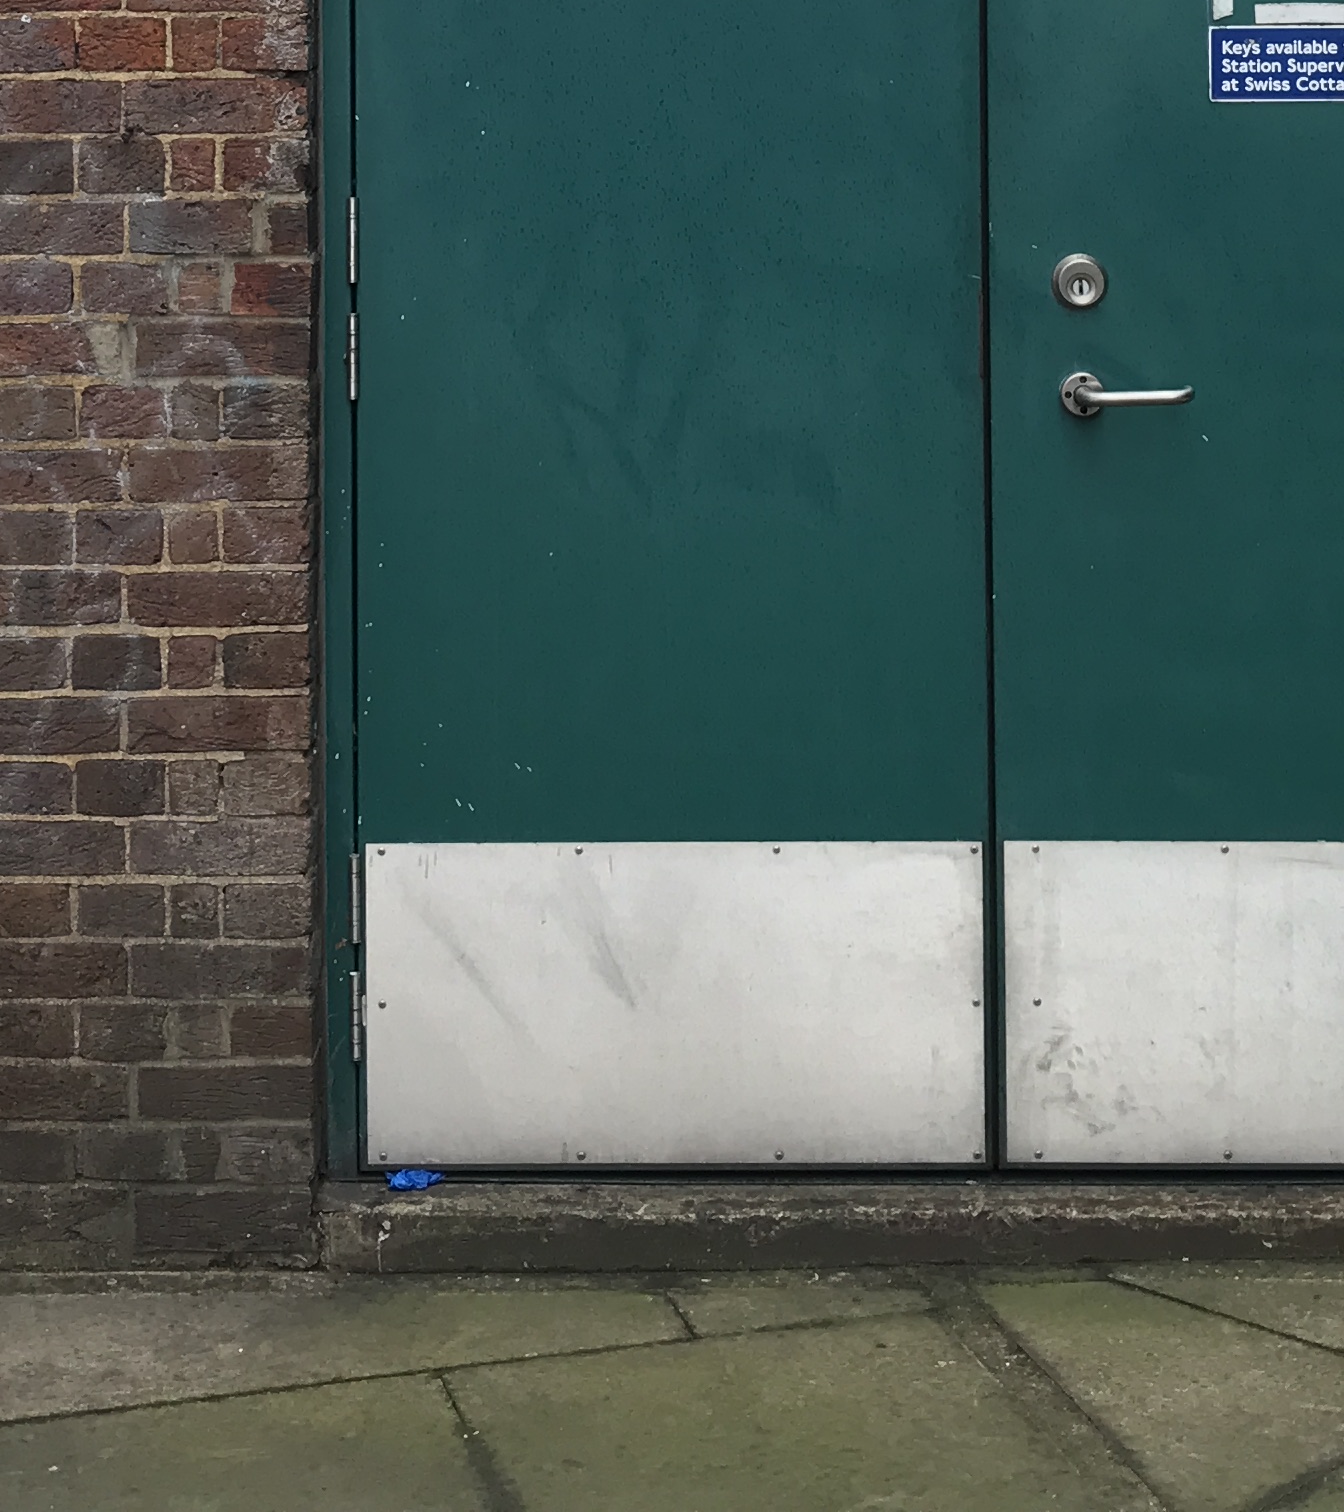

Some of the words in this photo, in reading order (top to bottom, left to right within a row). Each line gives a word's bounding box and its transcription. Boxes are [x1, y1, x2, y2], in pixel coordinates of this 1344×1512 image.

[1266, 40, 1338, 55] available
[1222, 58, 1282, 73] Station
[1222, 78, 1240, 92] at
[1244, 76, 1291, 92] Swiss
